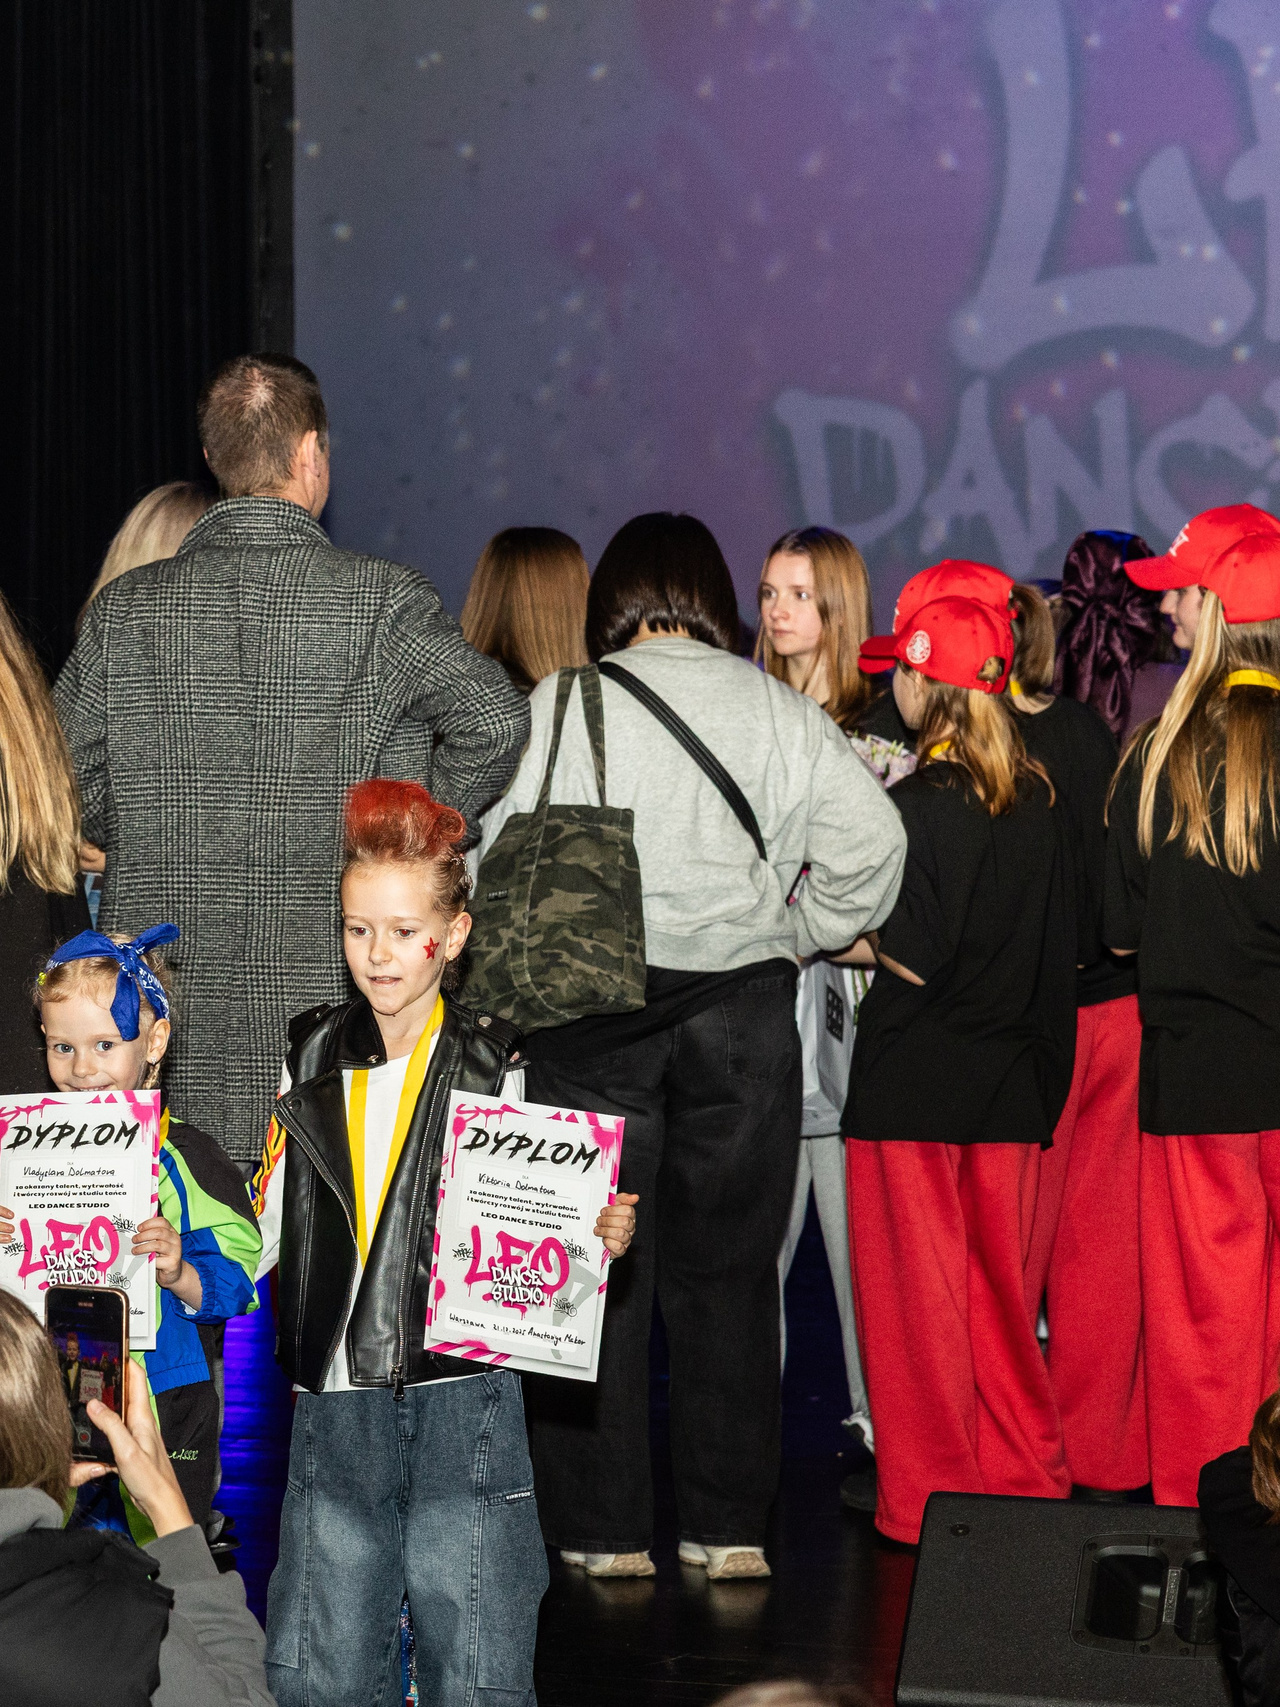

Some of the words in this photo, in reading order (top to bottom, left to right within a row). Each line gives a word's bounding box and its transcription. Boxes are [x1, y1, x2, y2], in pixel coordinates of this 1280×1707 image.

[3, 1118, 141, 1153] DYPLOM
[459, 1126, 601, 1175] DYPLOM
[509, 1196, 534, 1206] talent,
[531, 1206, 557, 1217] studiu
[480, 1211, 498, 1219] LEO
[499, 1214, 528, 1225] DANCE
[528, 1220, 562, 1231] STUDIO
[18, 1215, 120, 1278] LEO
[44, 1249, 98, 1270] DANCE
[464, 1225, 570, 1294] LEO
[48, 1266, 97, 1287] STUDIO
[491, 1266, 545, 1288] DANCE
[491, 1286, 545, 1305] STUDIO
